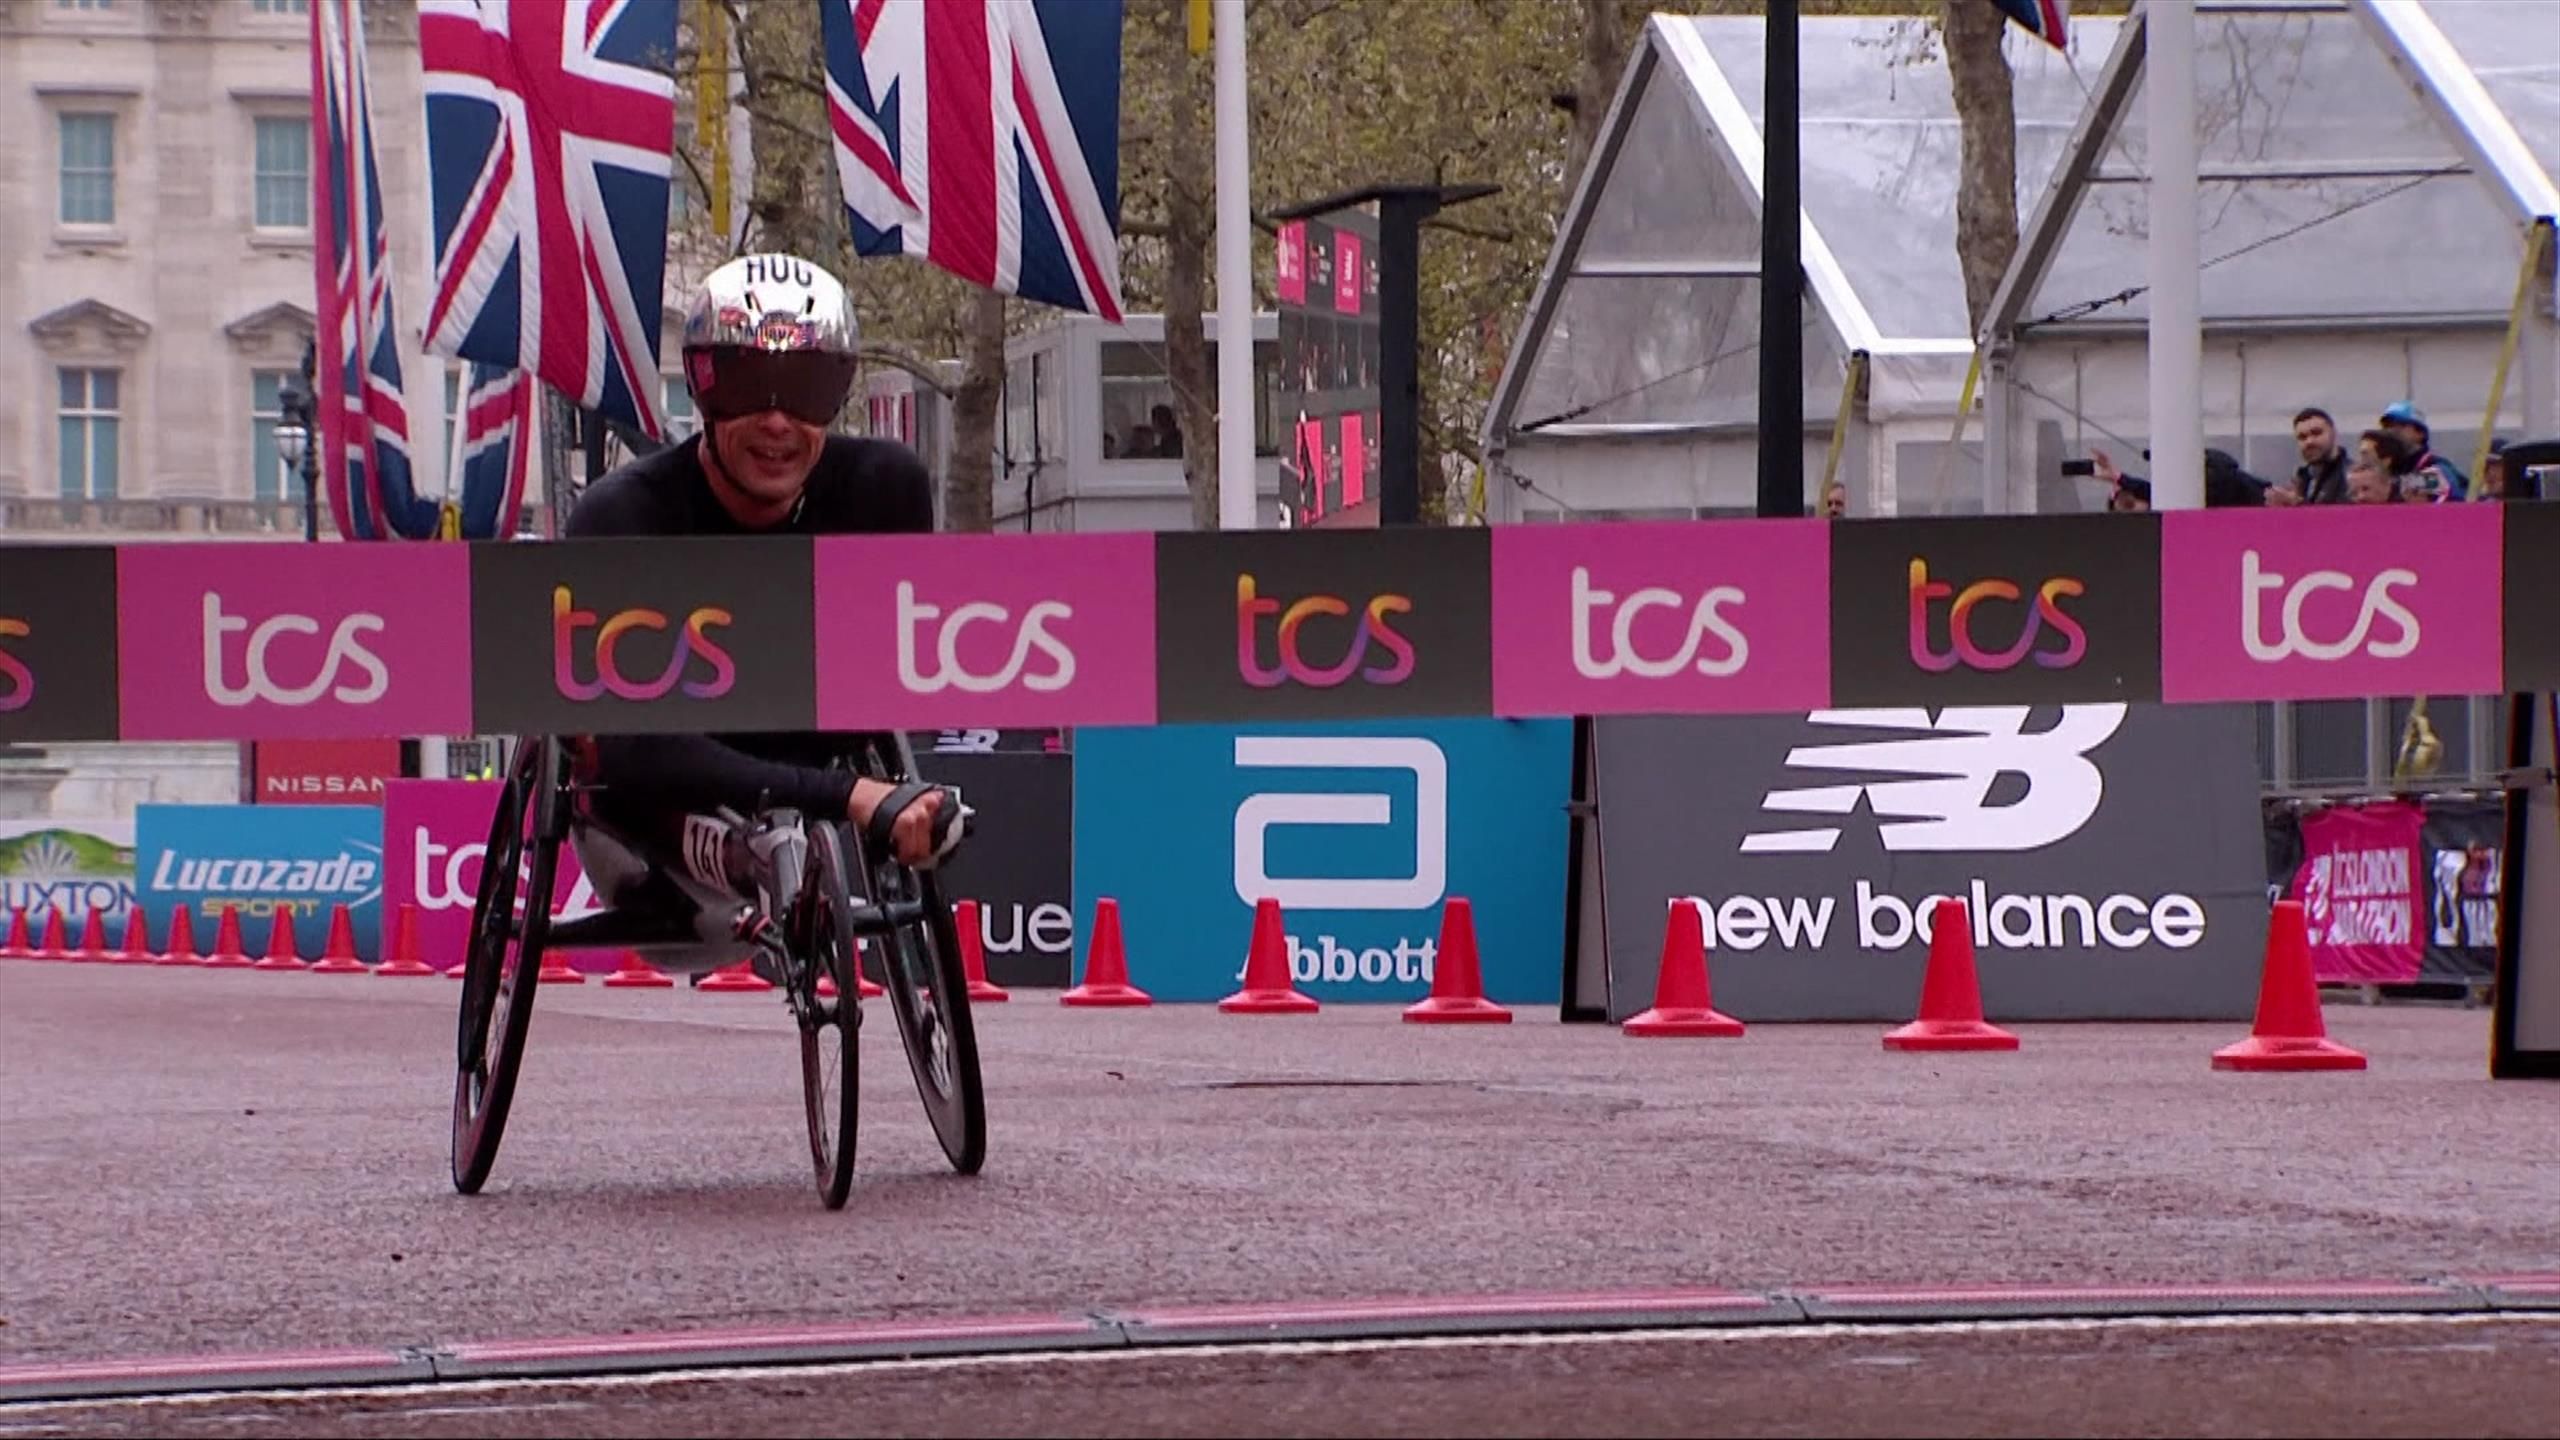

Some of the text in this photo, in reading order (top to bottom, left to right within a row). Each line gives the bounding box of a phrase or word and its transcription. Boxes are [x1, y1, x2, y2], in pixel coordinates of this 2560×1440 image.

[203, 591, 390, 706] tcs
[553, 584, 736, 702] tcs
[896, 580, 1077, 694] tcs
[1236, 573, 1417, 689] tcs
[1571, 566, 1749, 680] tcs
[1909, 556, 2088, 673] tcs
[2242, 549, 2421, 663] tcs
[267, 776, 385, 794] NISSAN
[2, 880, 137, 914] UXTON
[152, 849, 375, 892] Lucozade
[415, 825, 531, 911] tc
[1235, 935, 1438, 983] bbott
